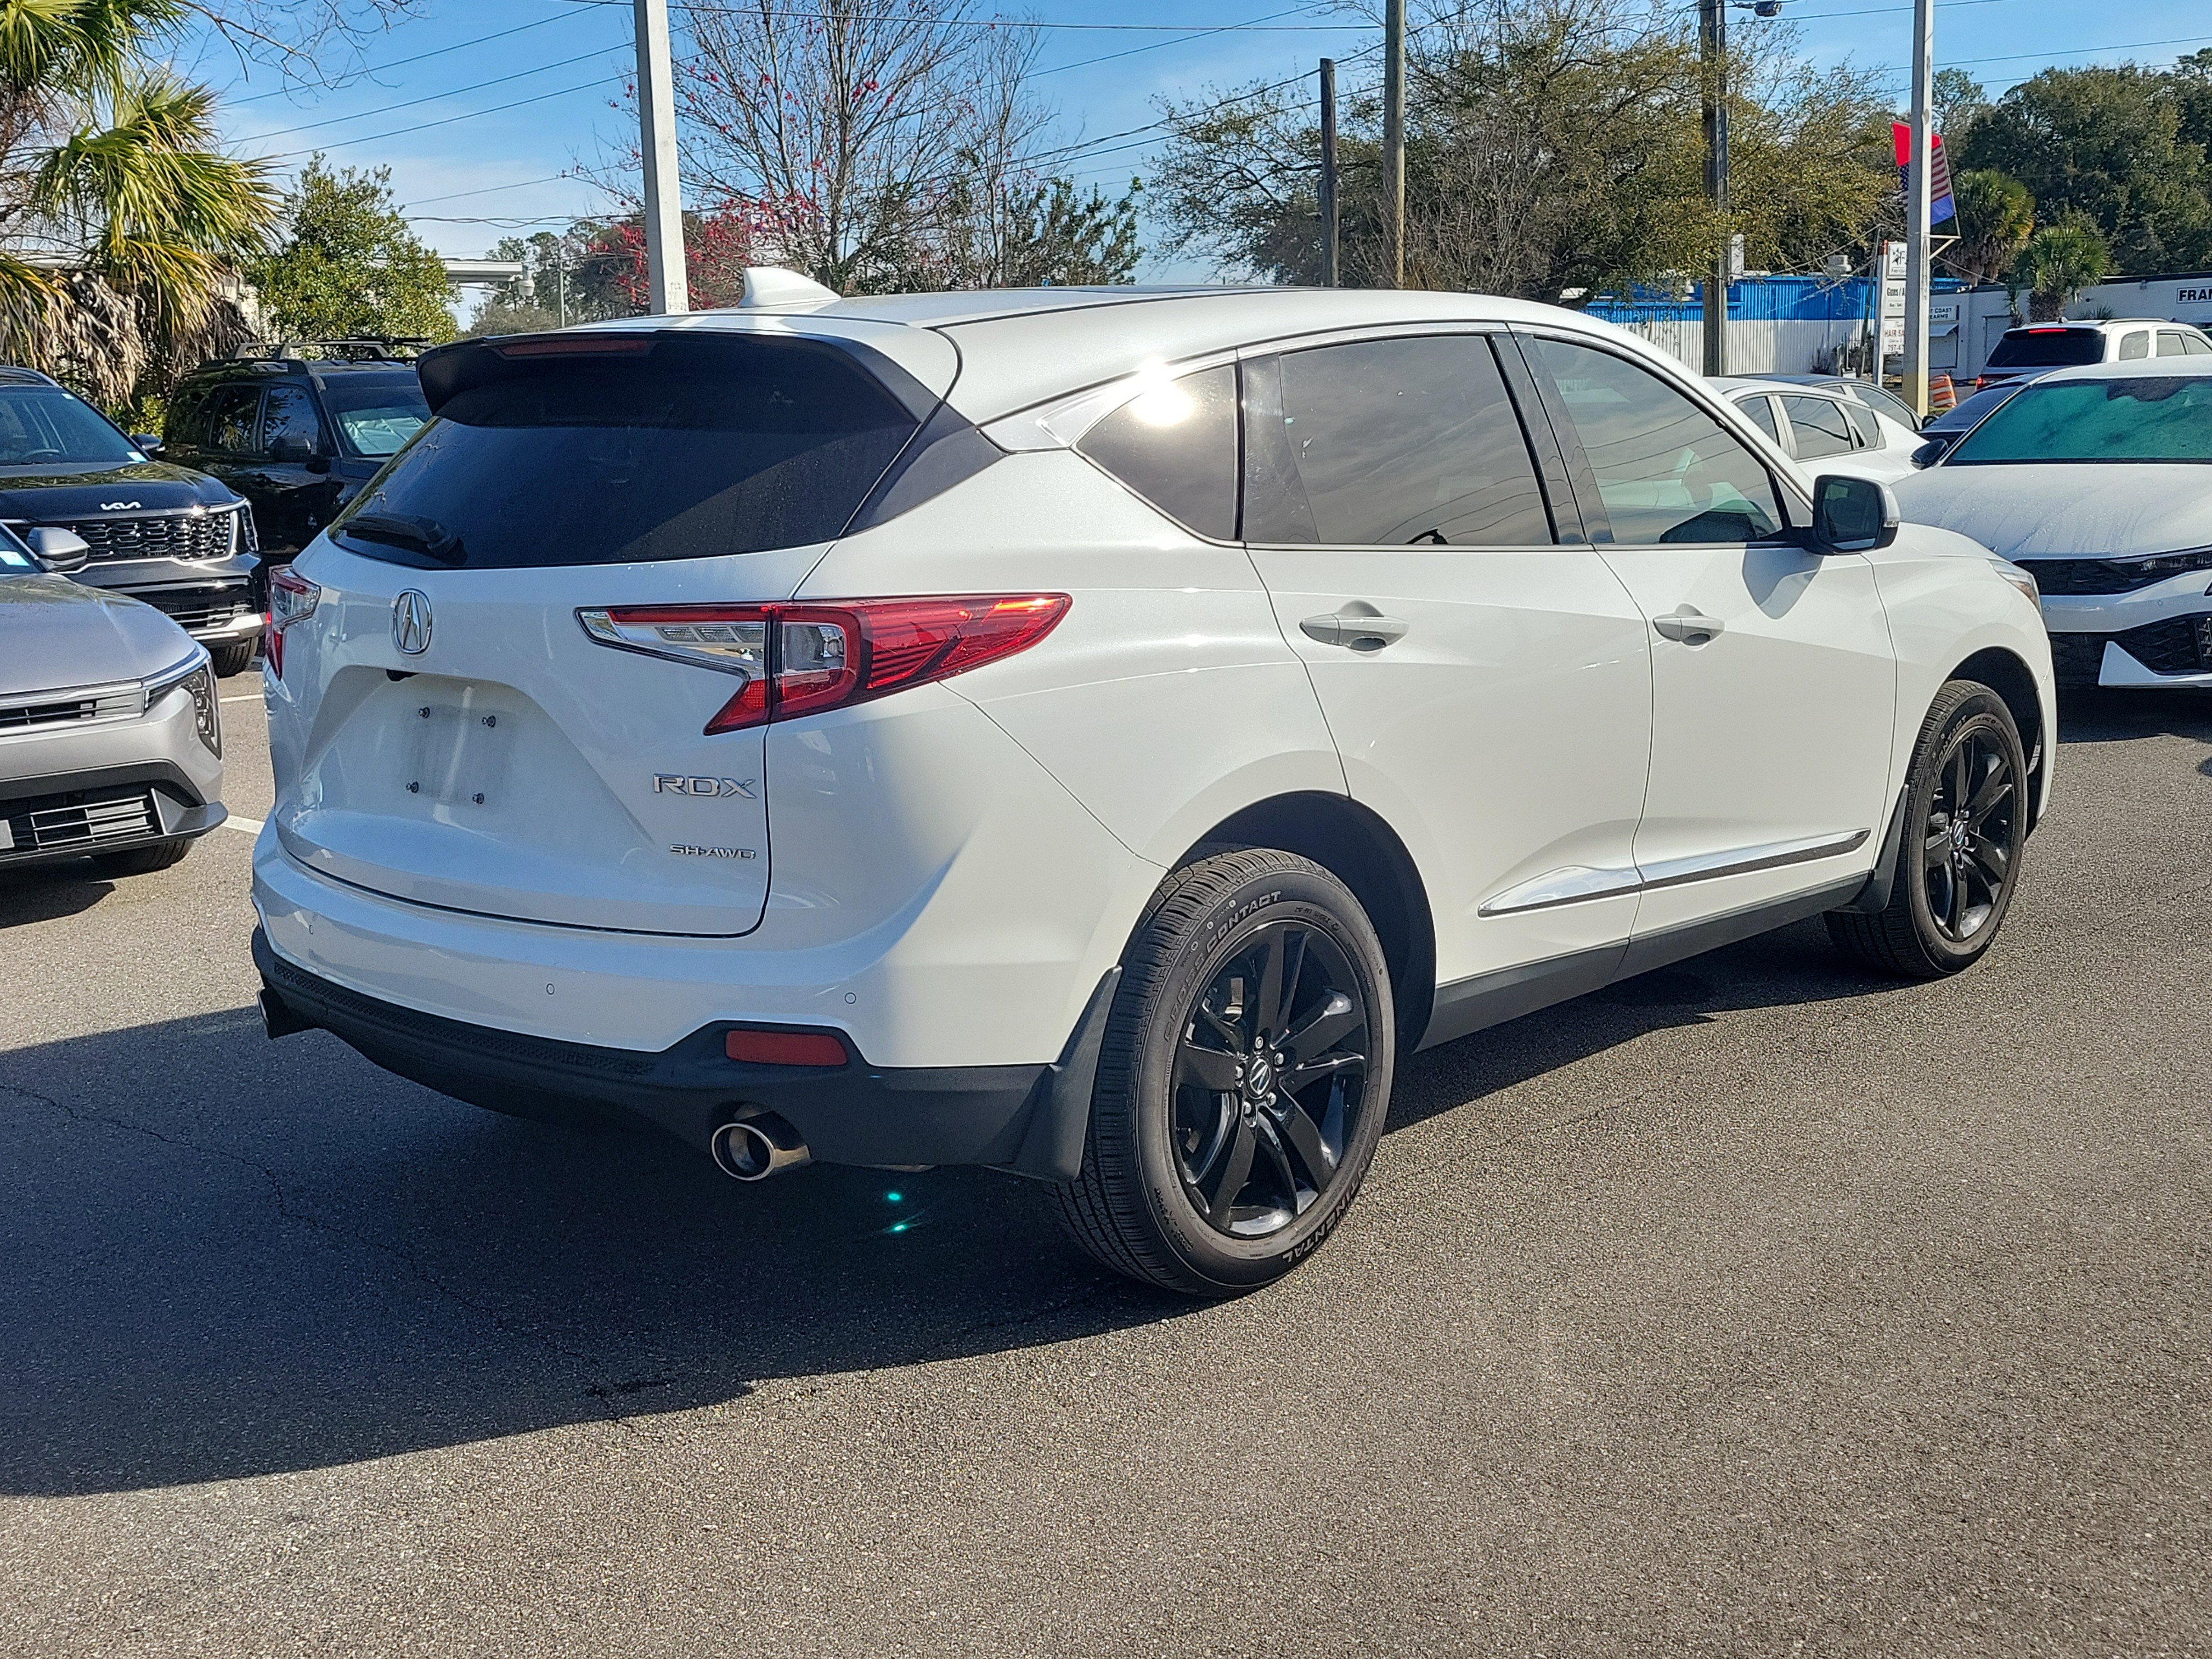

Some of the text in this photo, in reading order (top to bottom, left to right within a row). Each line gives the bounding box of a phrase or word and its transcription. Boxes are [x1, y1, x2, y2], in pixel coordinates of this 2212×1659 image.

[653, 773, 758, 799] RDX
[669, 844, 757, 860] SH-AWD
[1206, 890, 1282, 953] CONTACT
